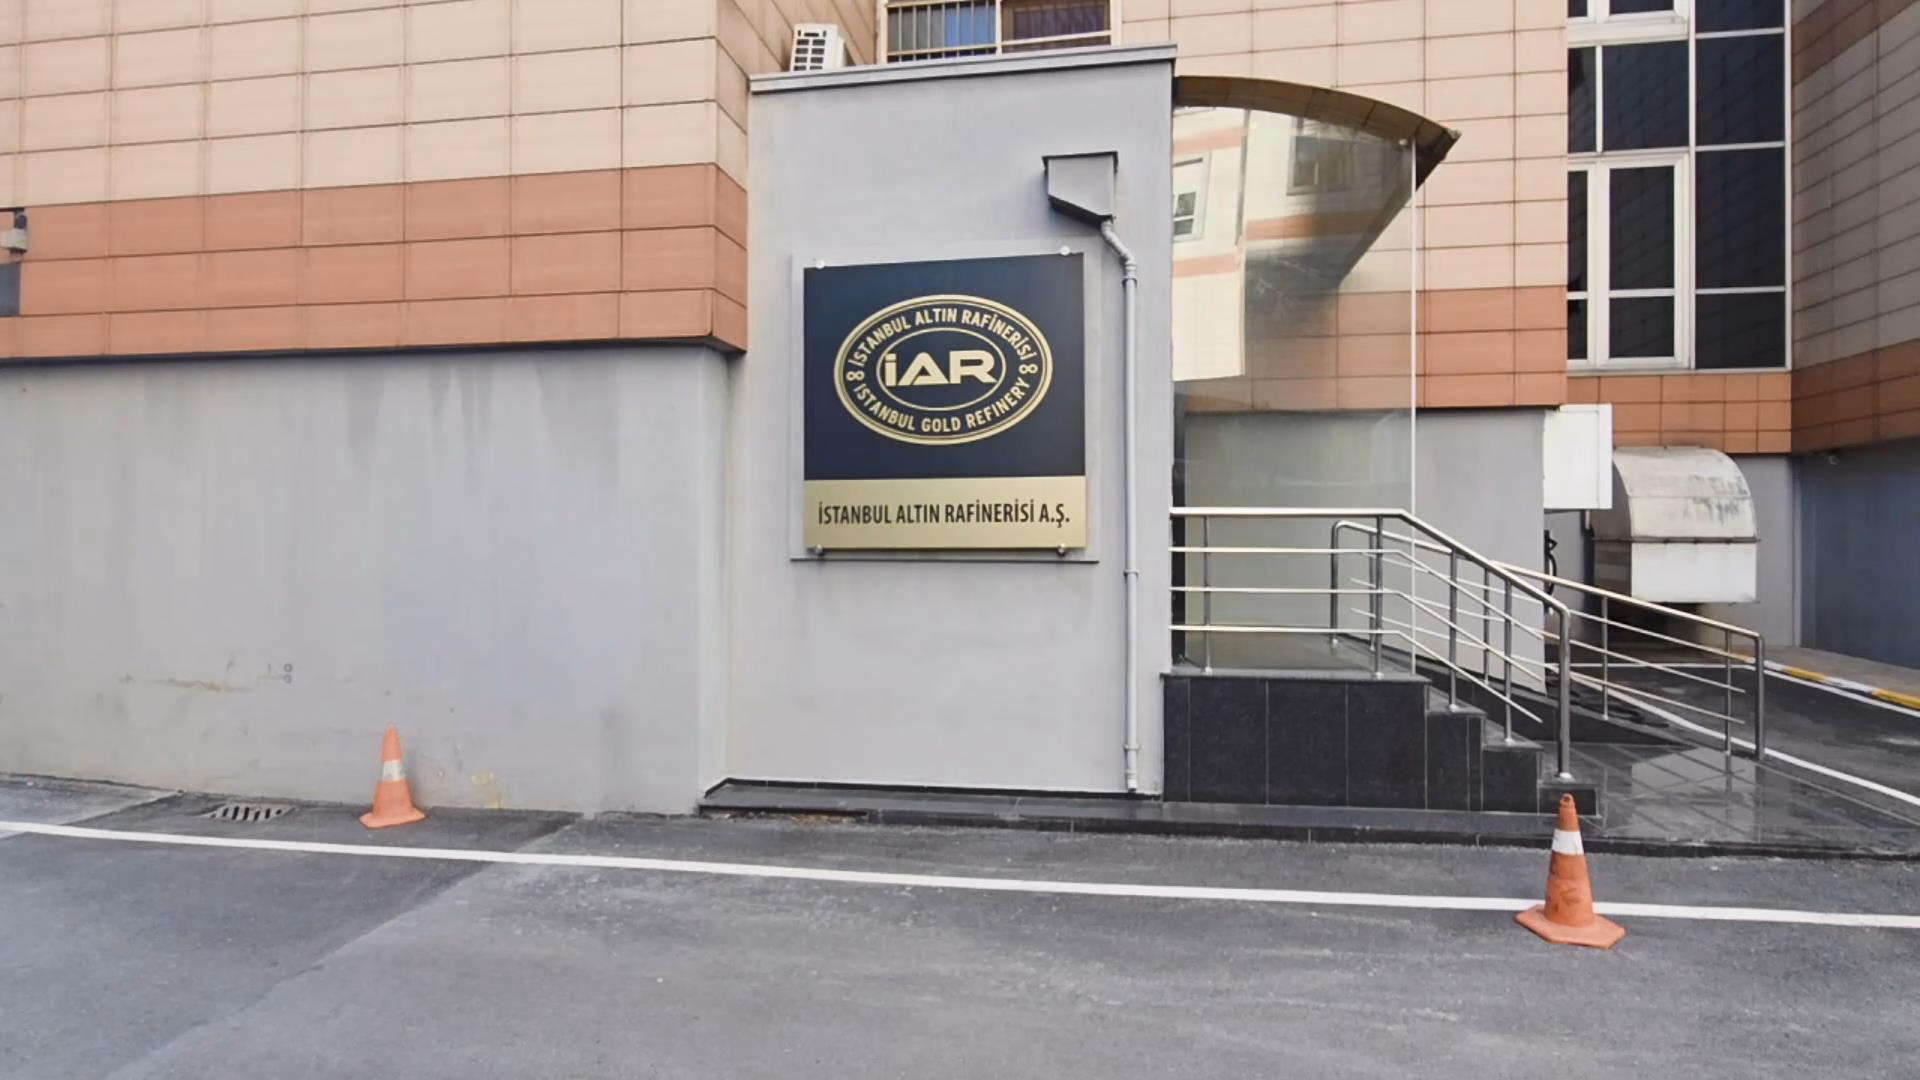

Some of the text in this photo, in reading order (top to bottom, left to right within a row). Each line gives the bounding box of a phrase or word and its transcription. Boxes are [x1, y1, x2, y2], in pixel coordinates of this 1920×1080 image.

[914, 307, 958, 326] ALTIN
[961, 309, 1038, 361] RAFİNERİSİ
[921, 417, 962, 433] GOLD
[965, 376, 1031, 429] REFINERY
[818, 498, 1071, 529] İSTANBUL ALTIN RAFİNERİSİ A.Ş.
